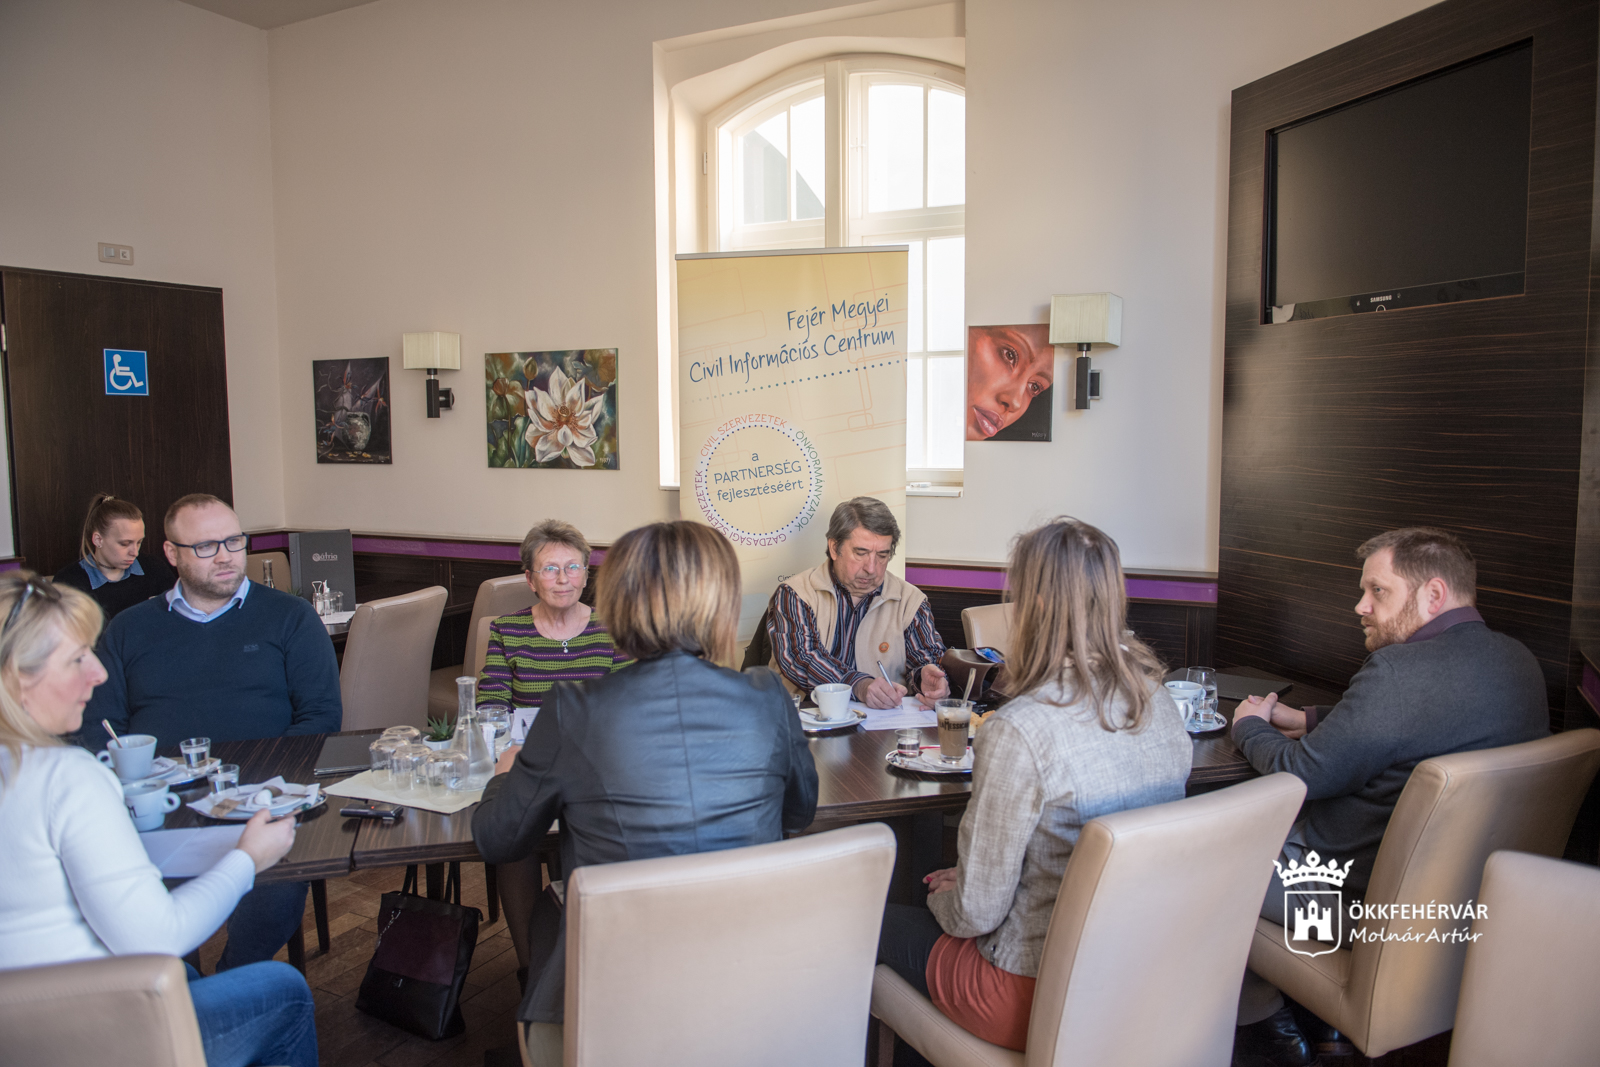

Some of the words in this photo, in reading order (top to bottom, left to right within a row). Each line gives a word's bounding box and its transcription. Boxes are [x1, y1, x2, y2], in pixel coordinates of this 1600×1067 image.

[787, 306, 826, 341] Fejér
[831, 293, 889, 329] Megyei
[1370, 295, 1392, 303] SAMSUNG
[689, 356, 723, 383] Civil
[729, 339, 819, 384] Információs
[823, 328, 895, 356] Centrum
[700, 435, 720, 457] CIVIL
[717, 413, 788, 436] SZERVEZETEK
[714, 459, 802, 485] PARTNERSÉG
[751, 453, 759, 462] a
[717, 479, 804, 503] fejlesztéséért
[794, 429, 826, 532] ÖNKORMÁNYZATOK
[694, 469, 730, 537] SZERVEZETEK
